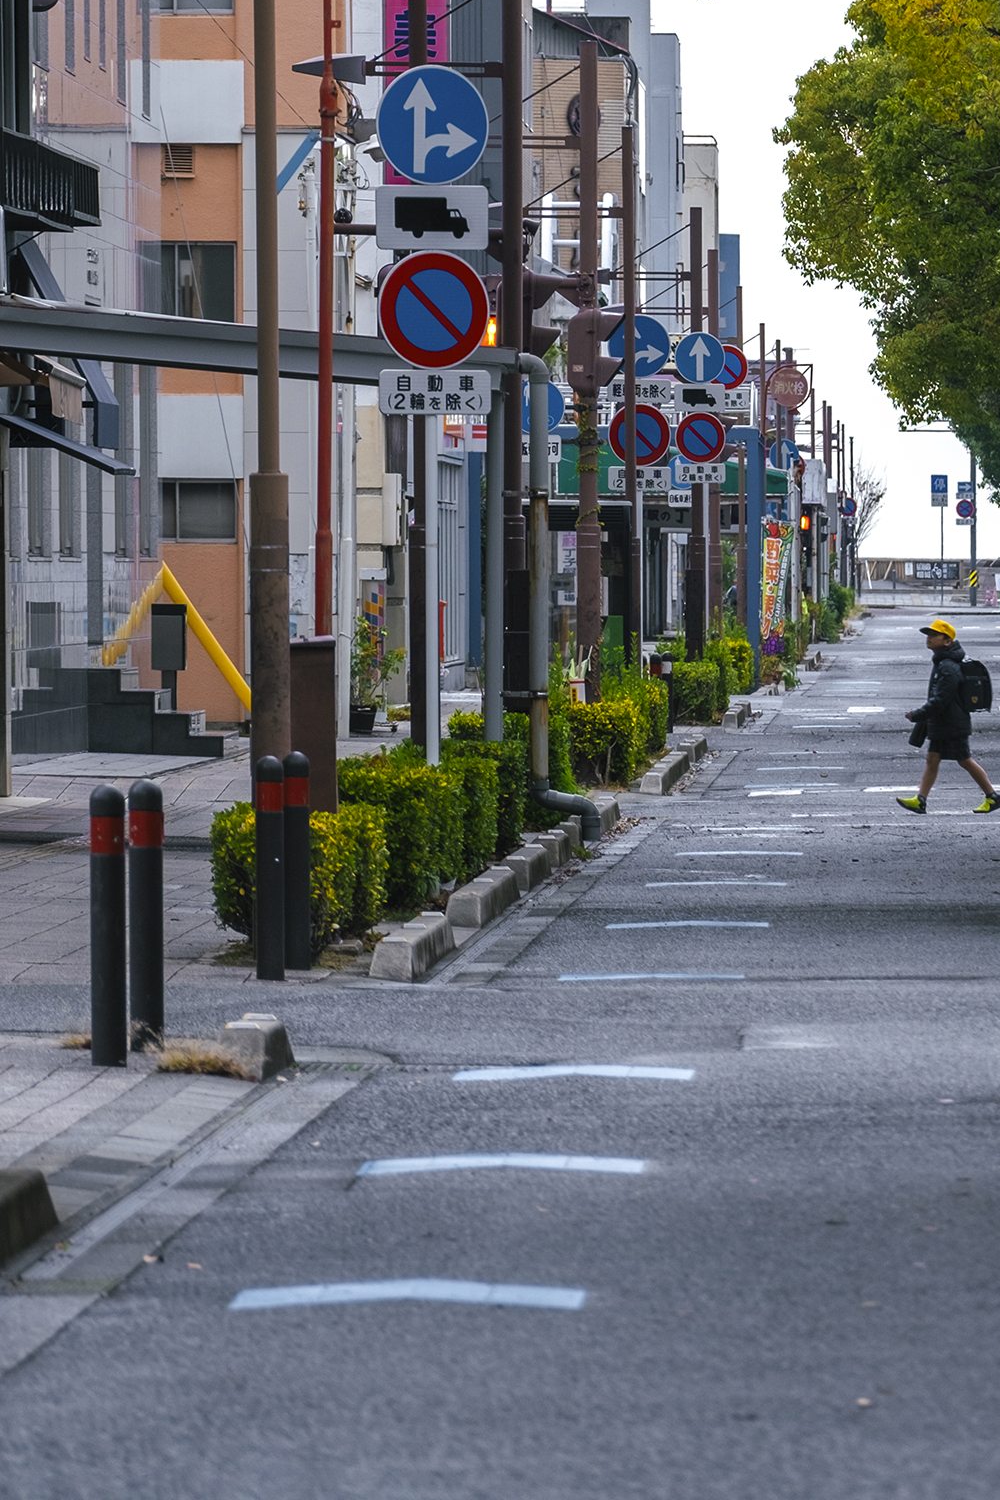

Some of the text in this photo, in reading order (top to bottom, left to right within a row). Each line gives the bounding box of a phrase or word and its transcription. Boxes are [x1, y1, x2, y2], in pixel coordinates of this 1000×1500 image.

[396, 374, 475, 393] 自動車
[774, 380, 805, 396] 消火栓
[612, 478, 668, 490] (2を除く)
